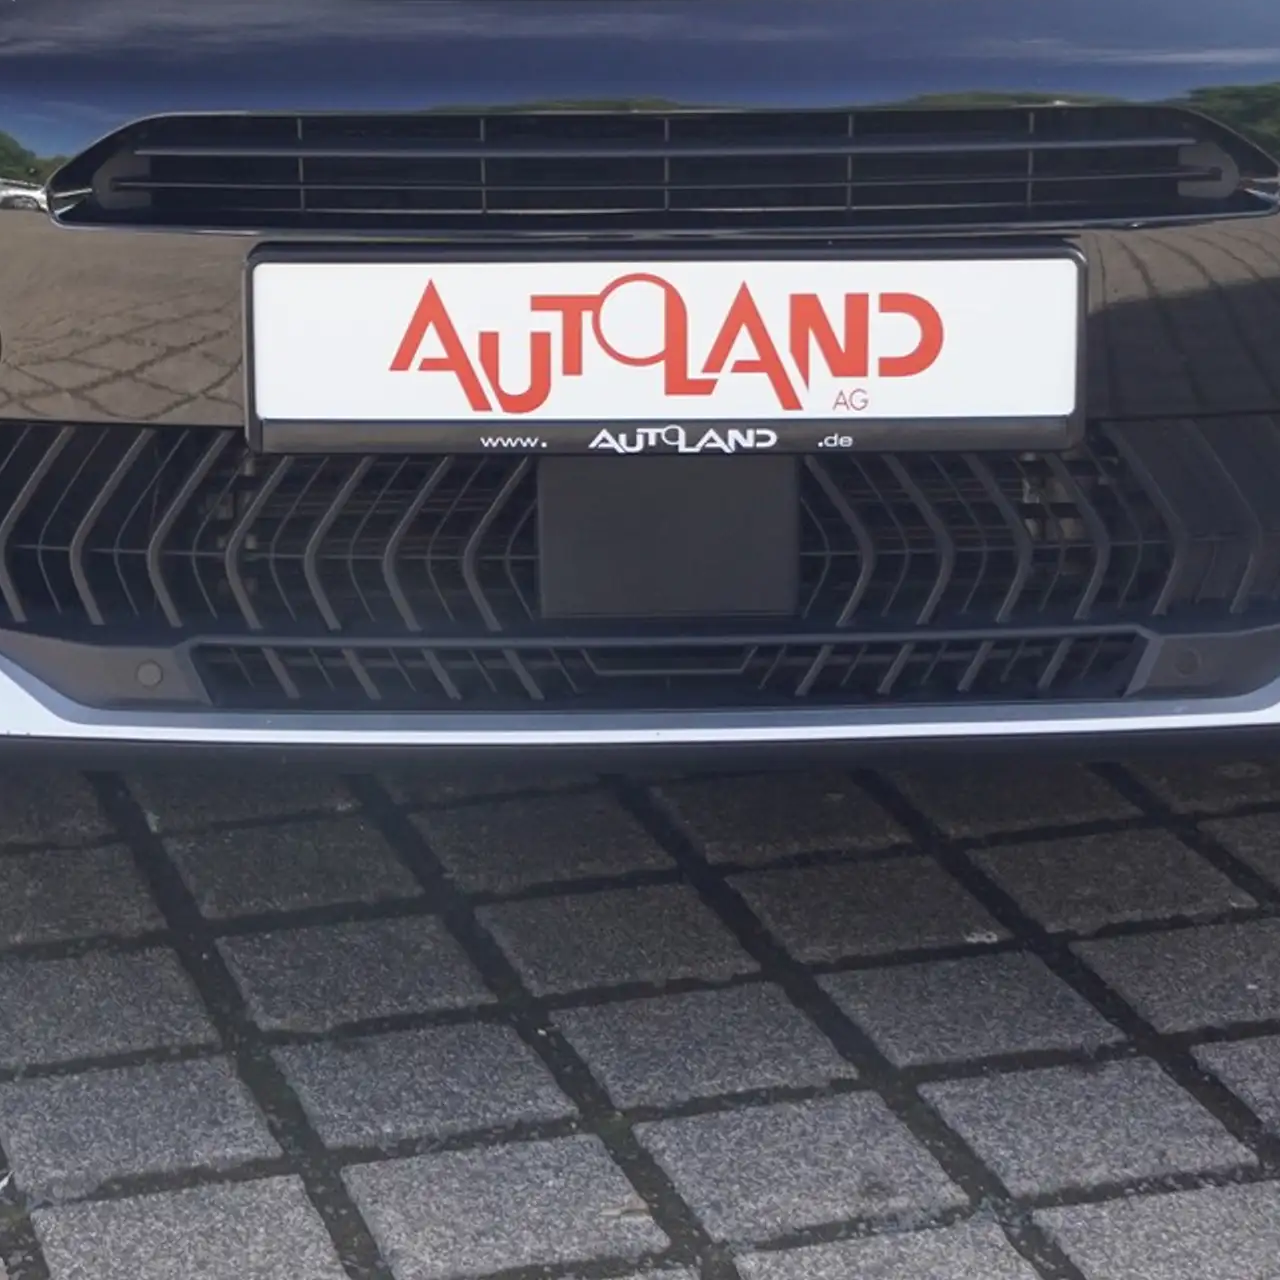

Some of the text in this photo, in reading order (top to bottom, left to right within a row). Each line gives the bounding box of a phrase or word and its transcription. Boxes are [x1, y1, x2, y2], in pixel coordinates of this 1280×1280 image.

[388, 272, 944, 414] AUTOLAND
[832, 388, 869, 411] AG
[480, 424, 853, 453] www. AUTOLAND .de
